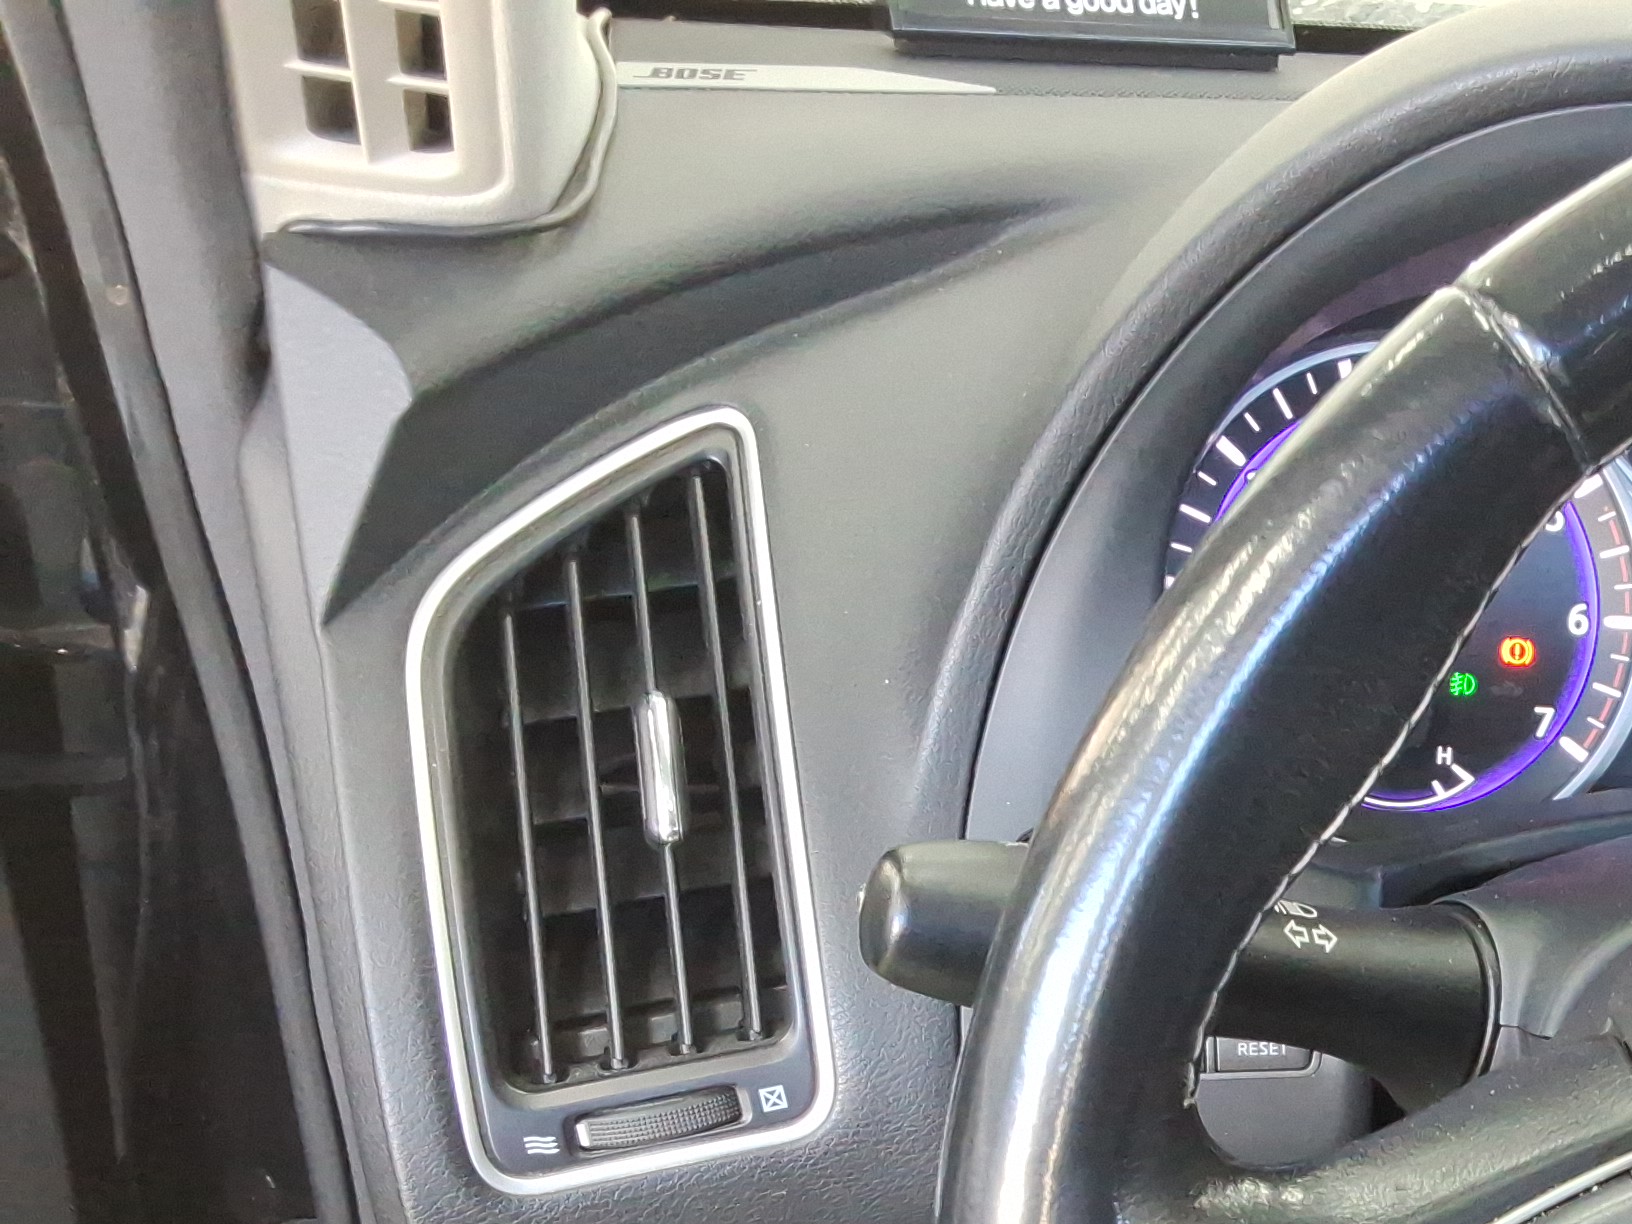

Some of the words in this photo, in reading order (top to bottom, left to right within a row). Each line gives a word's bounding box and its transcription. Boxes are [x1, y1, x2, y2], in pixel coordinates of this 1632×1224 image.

[1064, 0, 1133, 15] good
[1139, 0, 1199, 20] day!
[633, 67, 757, 81] BOSE
[1567, 603, 1589, 636] 6
[1534, 707, 1555, 738] 7
[1437, 746, 1452, 765] H
